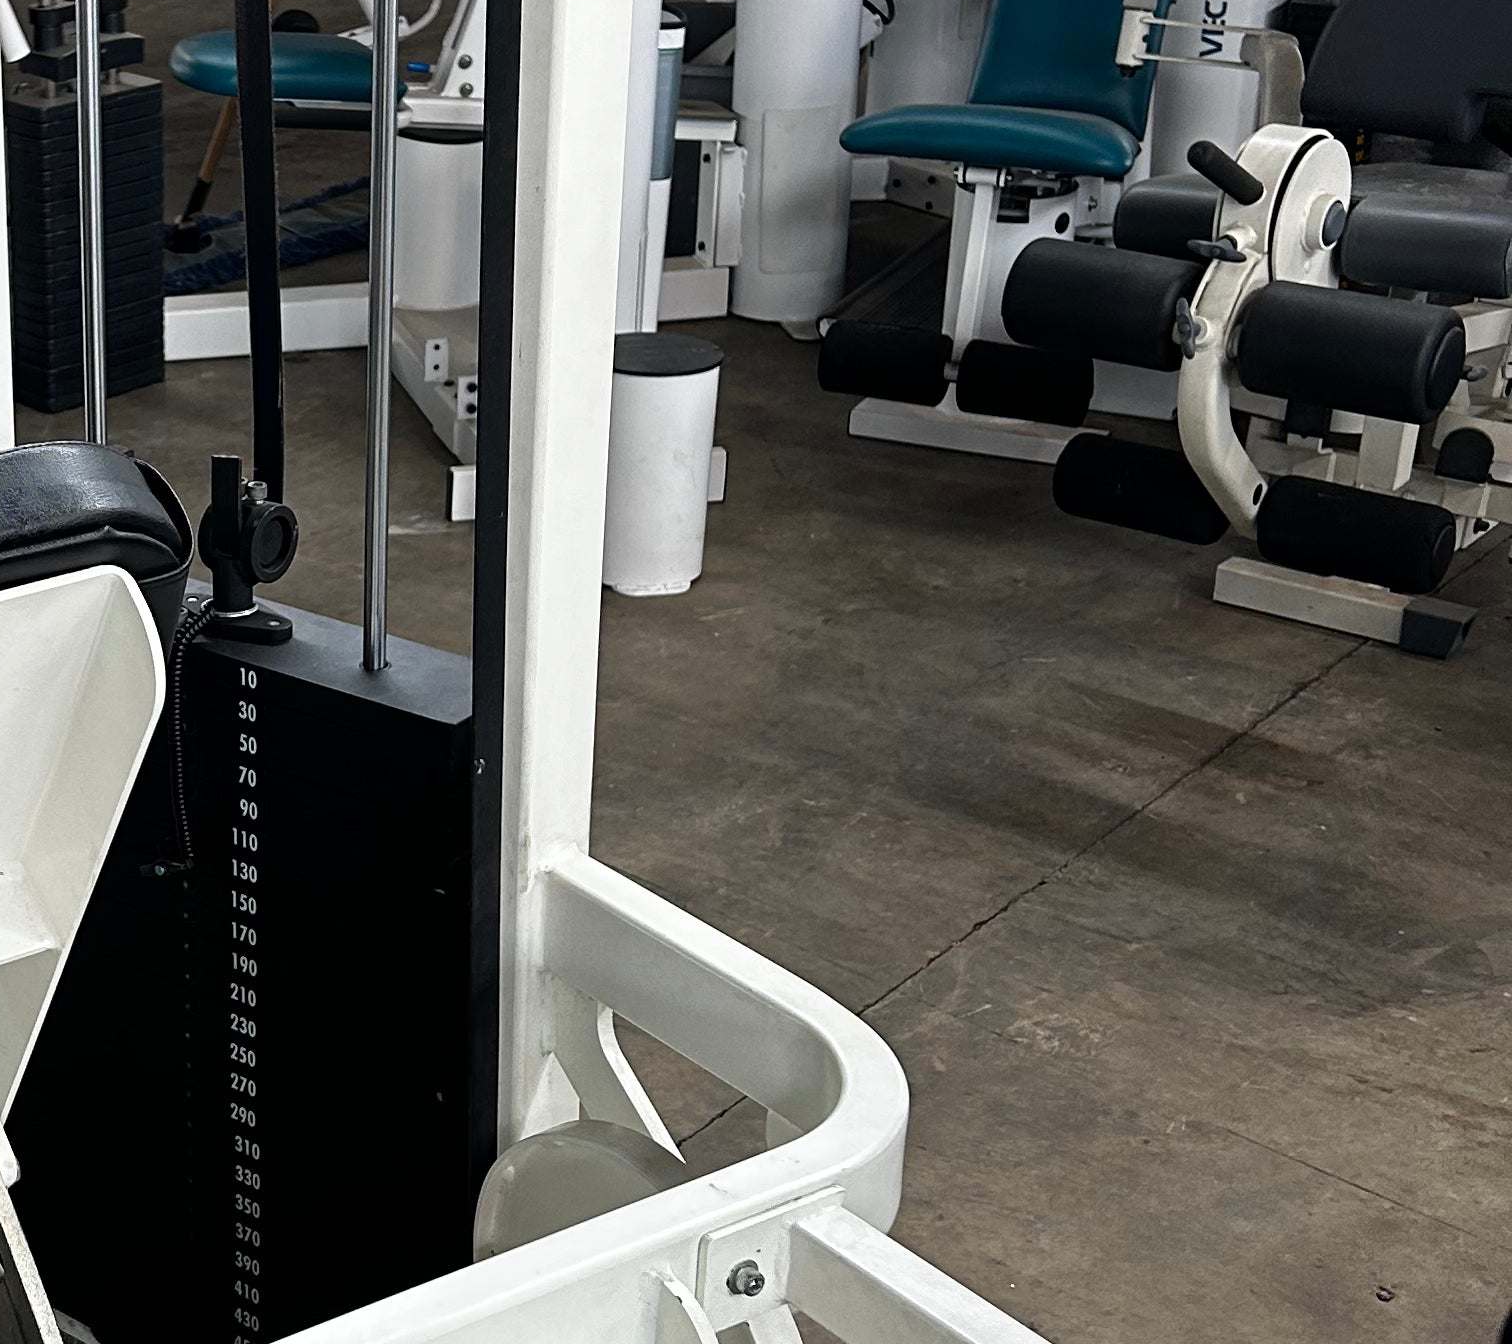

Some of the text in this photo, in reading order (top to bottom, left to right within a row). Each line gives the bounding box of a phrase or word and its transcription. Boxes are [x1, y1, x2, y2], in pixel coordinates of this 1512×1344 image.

[239, 667, 258, 690] 10
[238, 700, 257, 723] 30
[239, 733, 258, 755] 50
[238, 765, 257, 788] 70
[239, 798, 258, 821] 90
[231, 827, 259, 852] 110
[231, 858, 258, 884] 130
[231, 889, 257, 916] 150
[231, 921, 257, 946] 170
[231, 951, 258, 977] 190
[230, 982, 257, 1008] 210
[230, 1012, 257, 1038] 230
[229, 1042, 257, 1068] 250
[230, 1072, 257, 1097] 270
[230, 1102, 256, 1128] 290
[234, 1135, 261, 1161] 310
[235, 1164, 261, 1190] 330
[235, 1193, 261, 1219] 350
[235, 1222, 261, 1247] 370
[235, 1250, 260, 1276] 390
[234, 1280, 260, 1305] 410
[234, 1307, 260, 1332] 430
